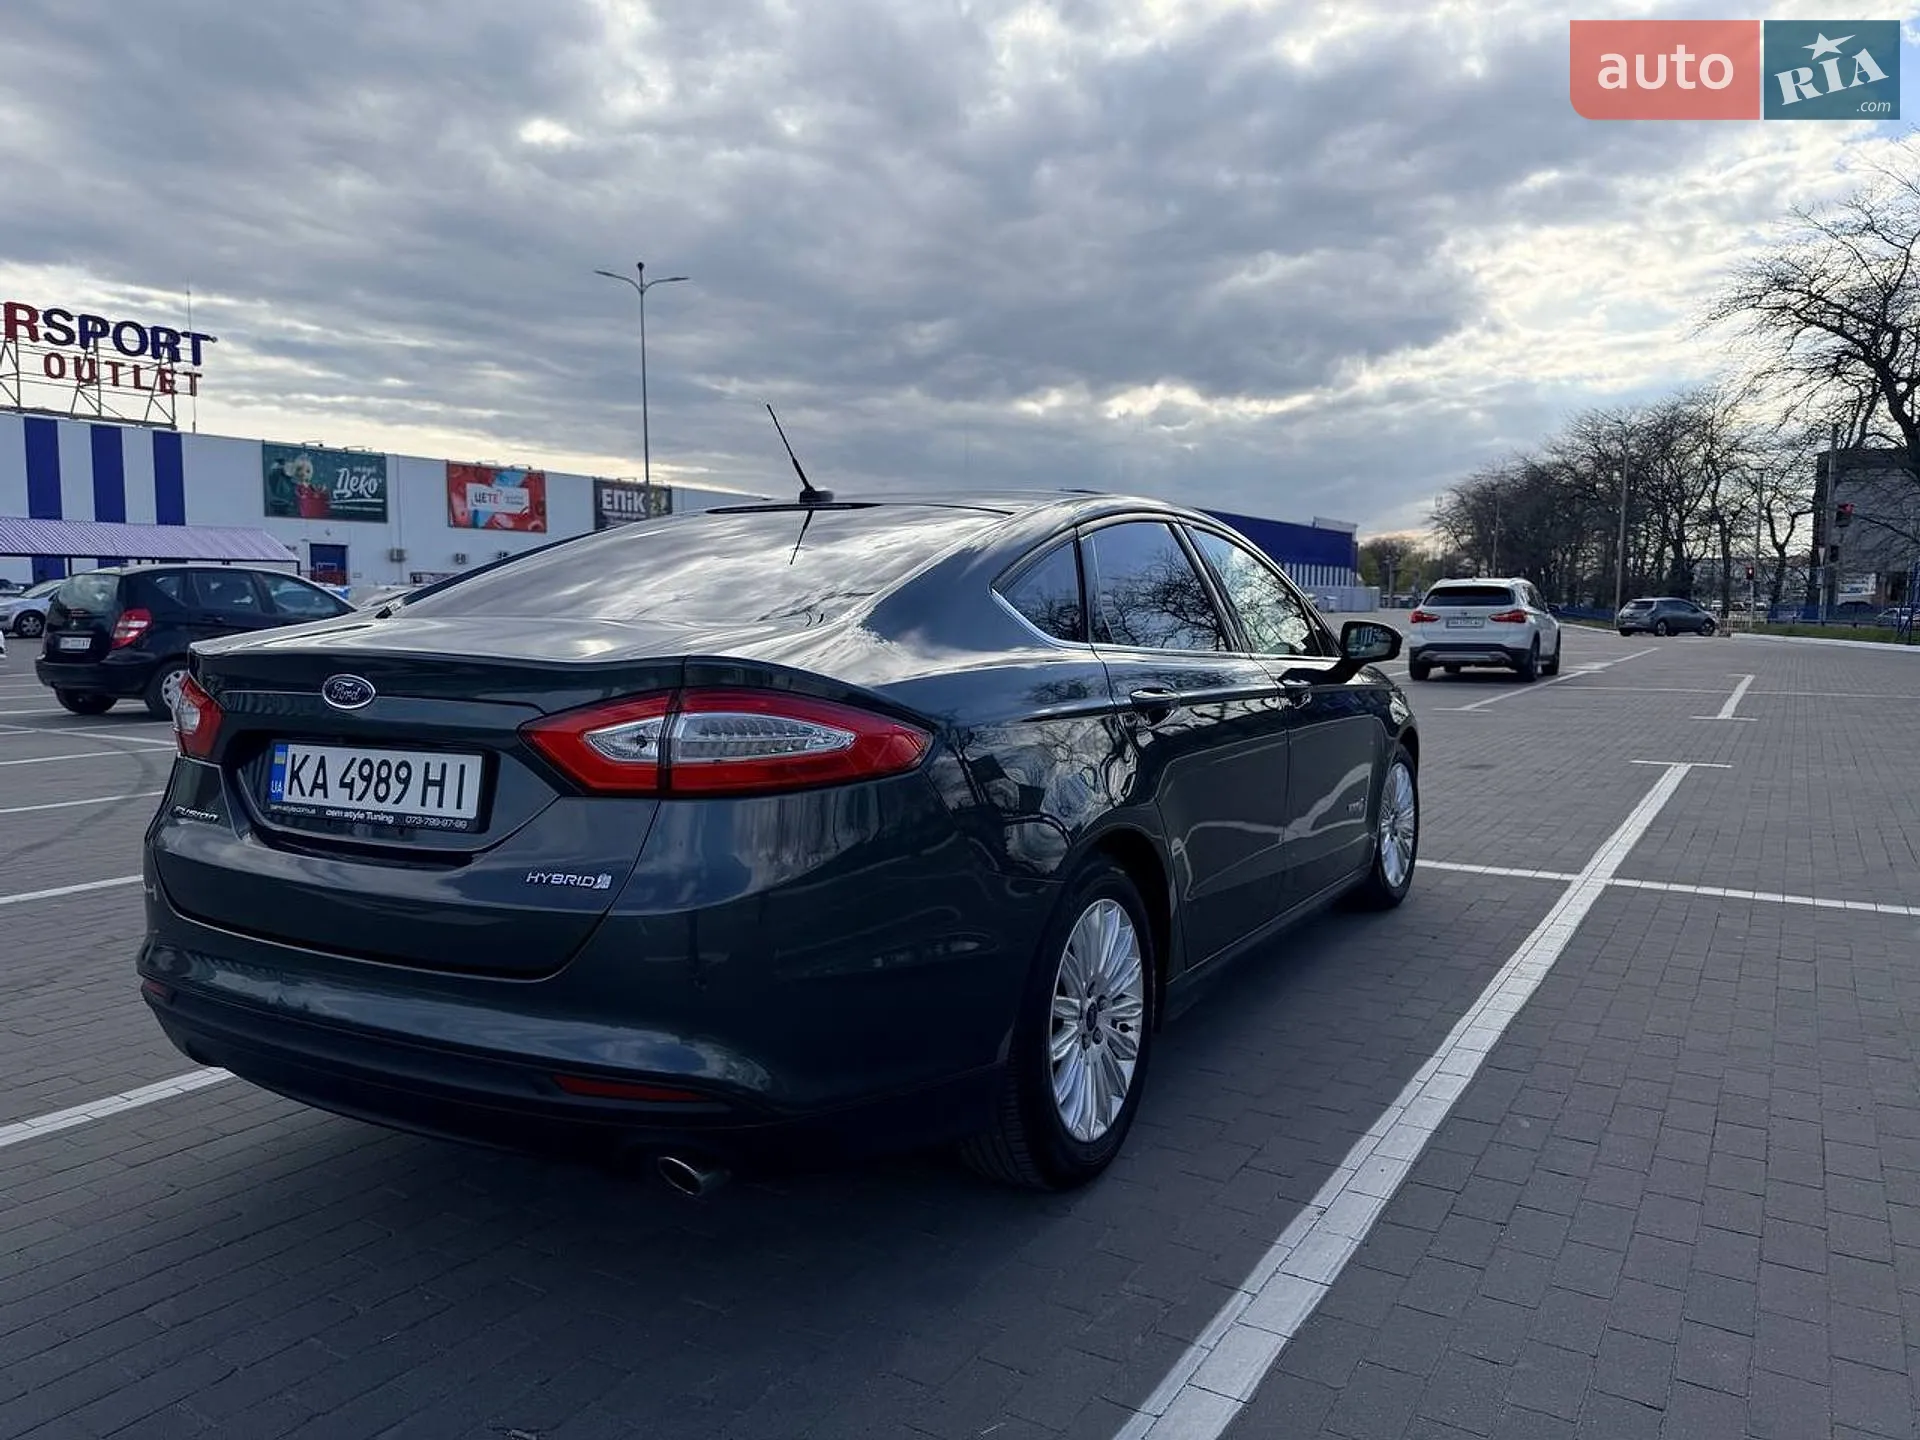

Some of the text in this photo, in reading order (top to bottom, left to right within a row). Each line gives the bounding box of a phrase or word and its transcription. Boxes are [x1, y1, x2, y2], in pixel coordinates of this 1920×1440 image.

[4, 302, 217, 366] RSPORT
[43, 352, 202, 396] OUTLET
[271, 780, 284, 793] UA
[288, 753, 328, 799] KA
[339, 757, 412, 805] 4989
[526, 872, 595, 887] HYBRID
